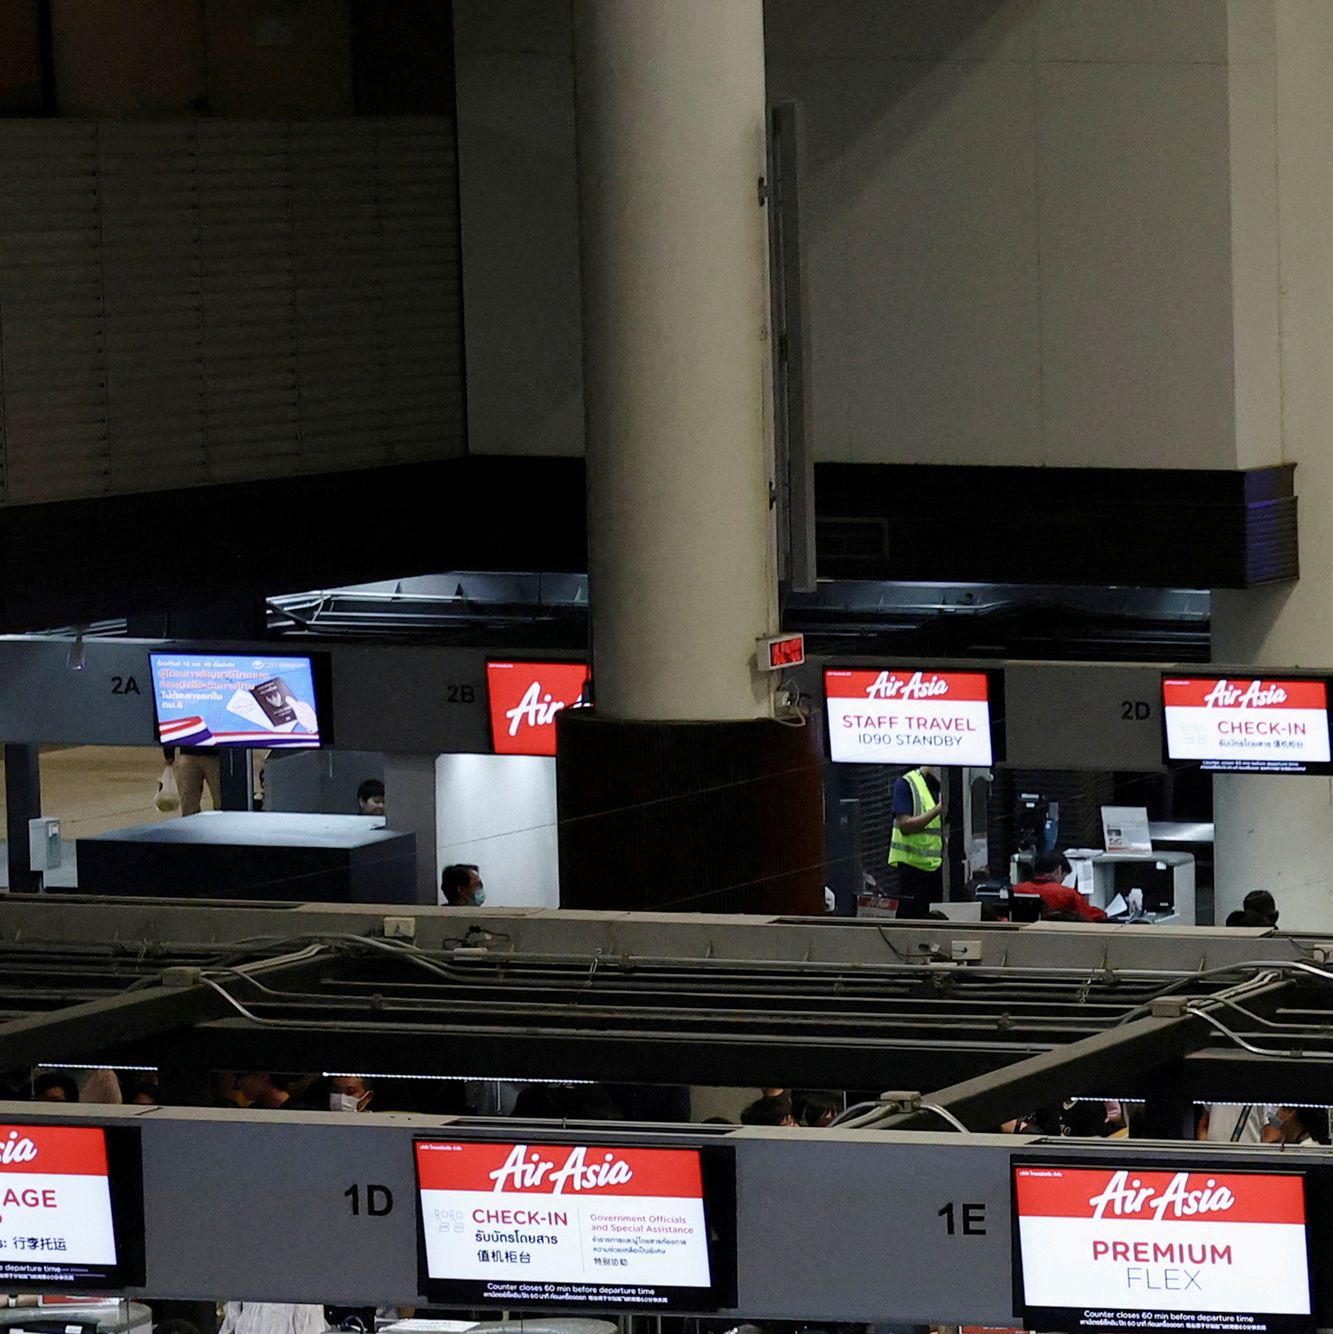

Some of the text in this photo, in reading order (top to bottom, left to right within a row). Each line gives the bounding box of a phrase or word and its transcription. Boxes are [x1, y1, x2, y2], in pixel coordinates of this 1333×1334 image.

[110, 675, 140, 696] 2A
[446, 684, 475, 703] 2B
[1121, 702, 1151, 721] 2D
[842, 715, 976, 732] STAFF TRAVEL
[1217, 719, 1307, 736] CHECK-IN
[857, 732, 963, 748] ID90 STANDBY
[343, 1183, 394, 1217] 1D
[471, 1209, 569, 1227] CHECK-IN
[590, 1213, 687, 1225] Government Officials
[937, 1202, 987, 1236] 1E
[591, 1224, 694, 1235] and Special Assistance
[1092, 1240, 1233, 1266] PREMIUM
[5, 1263, 61, 1275] departure time
[1127, 1267, 1202, 1291] FLEX
[487, 1282, 655, 1296] Counter closes 60 min before departure time
[1083, 1309, 1254, 1323] Counter closes 60 min before departure time
